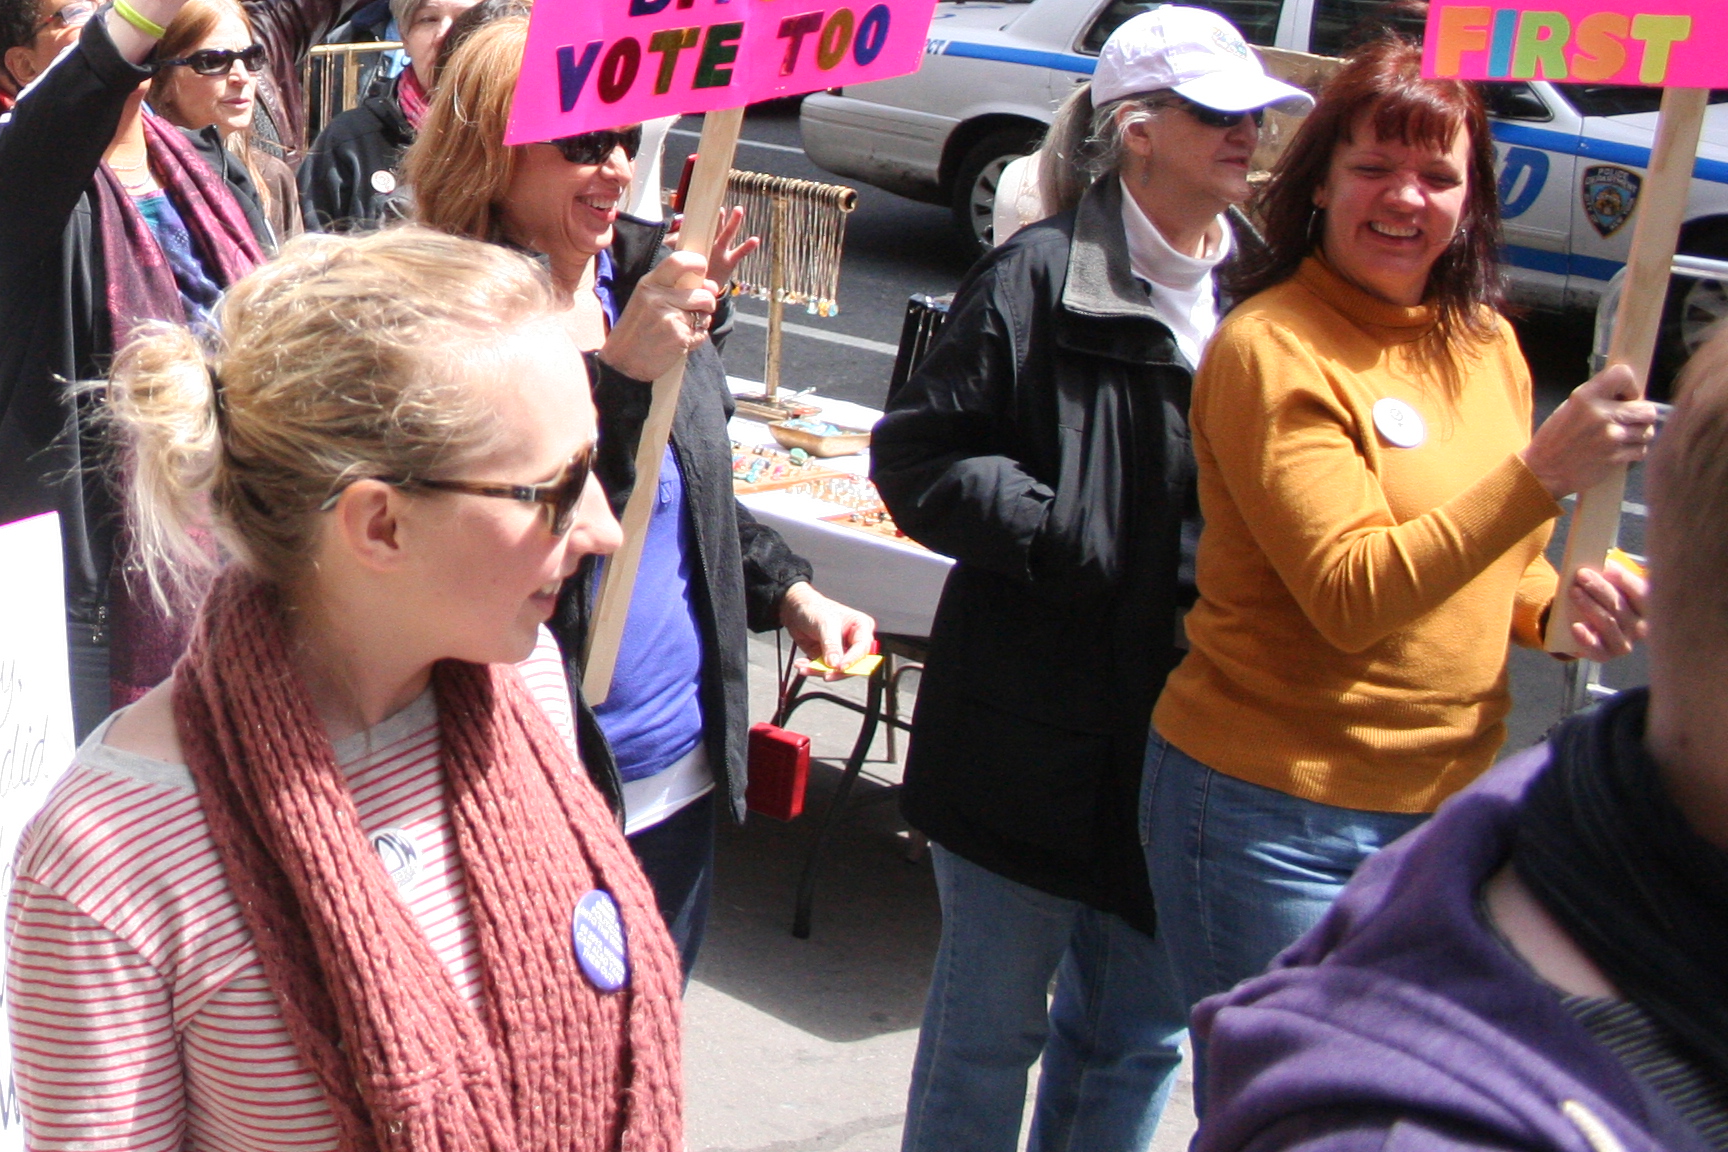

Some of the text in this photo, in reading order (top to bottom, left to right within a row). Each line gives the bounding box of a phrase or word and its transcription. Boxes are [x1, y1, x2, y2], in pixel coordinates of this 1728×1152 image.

[555, 4, 890, 113] VOTE TOO
[1436, 6, 1692, 85] FIRST
[0, 714, 49, 798] did
